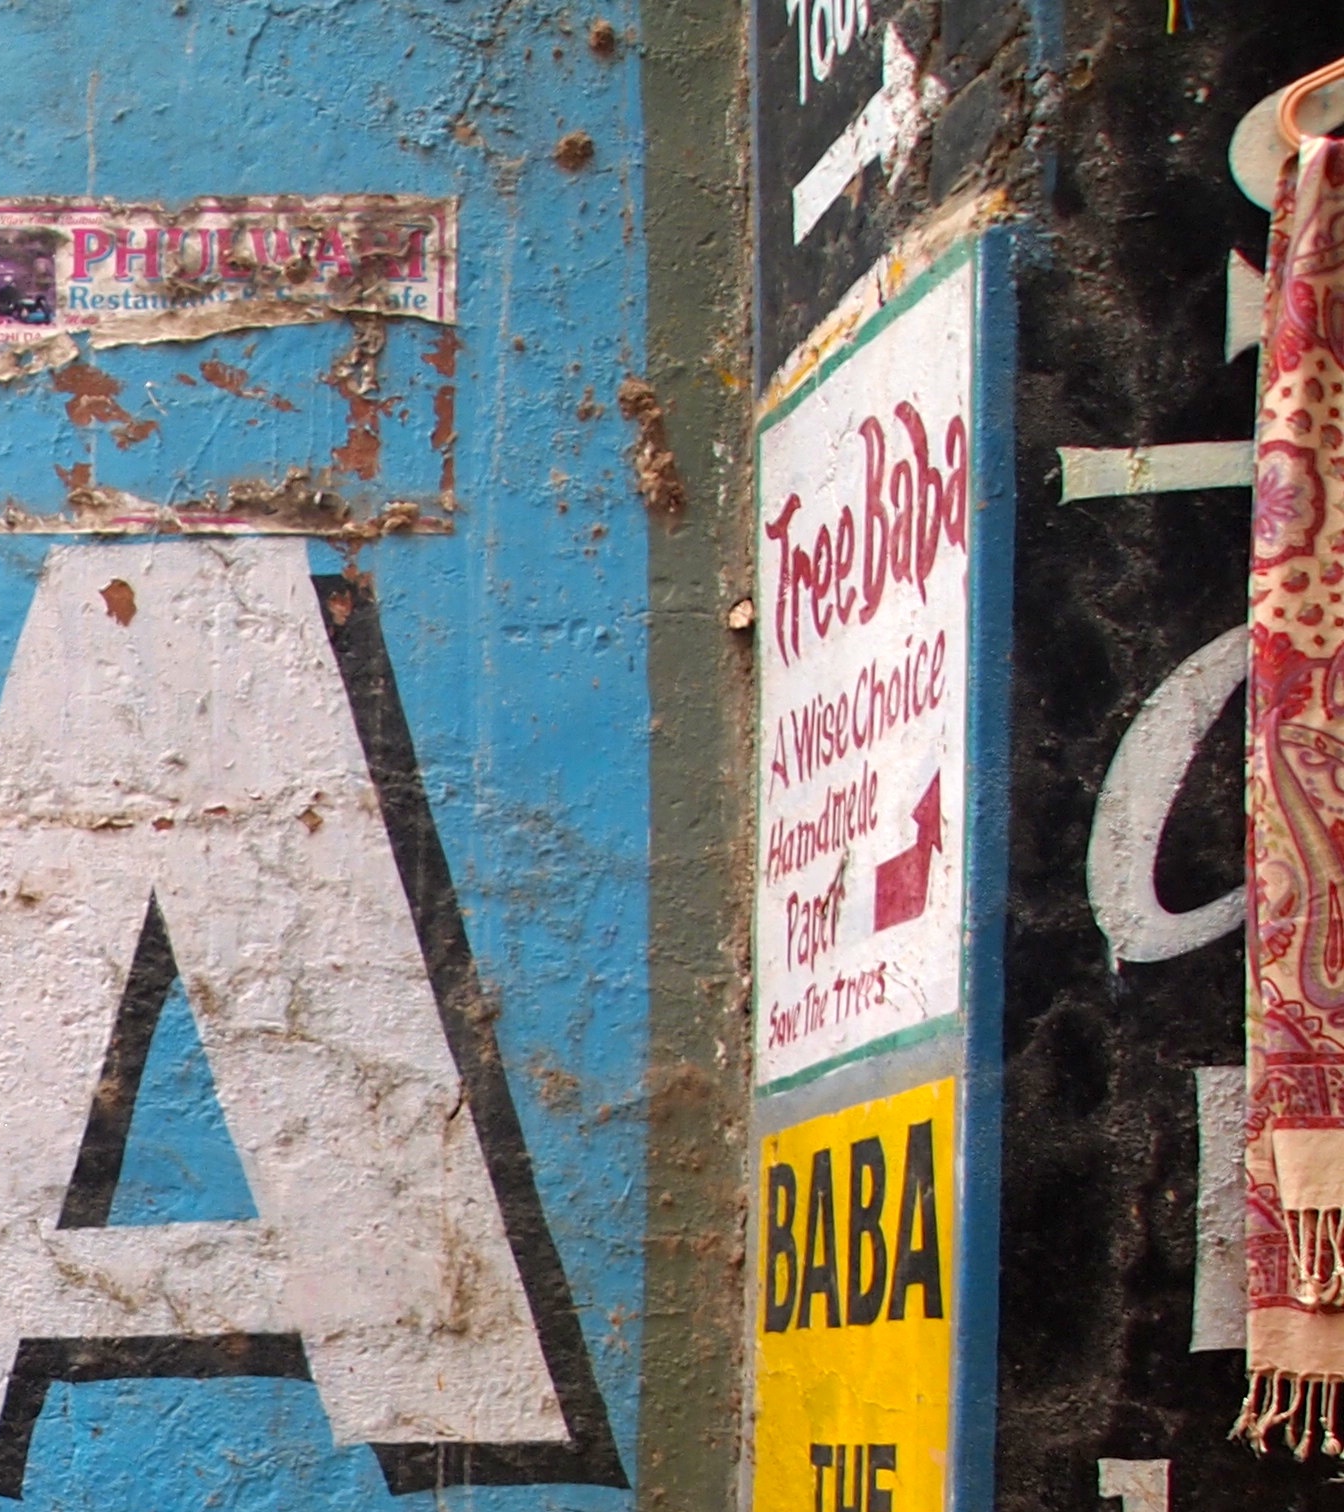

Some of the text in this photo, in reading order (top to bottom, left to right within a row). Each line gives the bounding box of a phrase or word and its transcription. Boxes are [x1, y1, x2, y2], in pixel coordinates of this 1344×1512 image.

[765, 400, 967, 668] Tree Baba
[768, 630, 946, 804] A Wise Choice
[786, 883, 846, 972] Paper
[769, 1000, 801, 1050] Save
[764, 1118, 944, 1333] BABA
